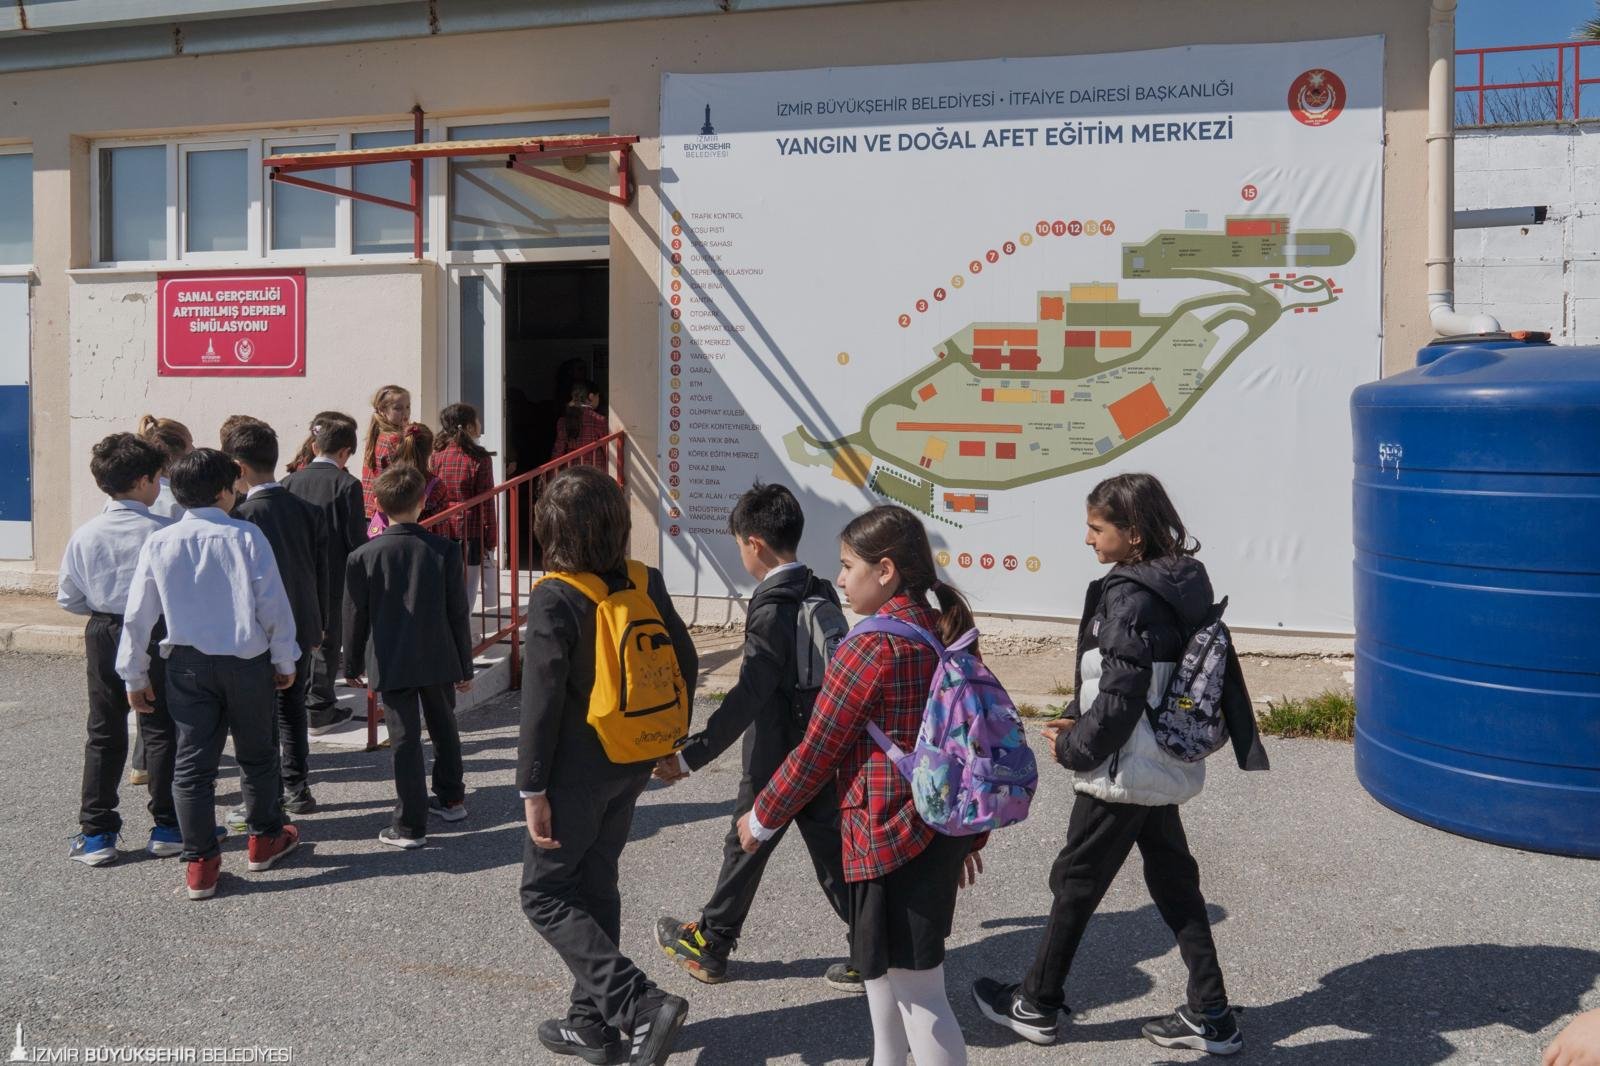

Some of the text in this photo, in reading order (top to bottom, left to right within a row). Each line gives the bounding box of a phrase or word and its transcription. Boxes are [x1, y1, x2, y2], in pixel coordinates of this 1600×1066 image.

[777, 80, 1234, 117] İZMİR BÜYÜKŞEHİR BELEDİYESİ İTFAİYE DAİRESİ BAŞKANLIĞI
[776, 115, 1233, 156] YANGIN VE DOĞAL AFET EĞİTİM MERKEZİ
[1243, 188, 1256, 198] 15
[1038, 224, 1048, 233] 10
[1054, 224, 1063, 233] 11
[1070, 224, 1080, 233] 12
[1086, 224, 1096, 233] 13
[1102, 224, 1112, 232] 14
[1023, 235, 1029, 244] 9
[1006, 244, 1012, 253] 8
[989, 252, 996, 261] 7
[972, 263, 979, 272] 6
[178, 287, 280, 303] SANAL GERÇEKLİĞİ
[937, 290, 943, 299] 4
[919, 302, 925, 310] 3
[173, 305, 286, 318] ARTTIRILMIŞ DEPREM
[190, 318, 268, 332] SİMÜLASYONU
[902, 316, 908, 325] 2
[960, 556, 971, 565] 18
[982, 558, 993, 566] 19
[1004, 559, 1017, 567] 20
[1027, 560, 1038, 568] 21
